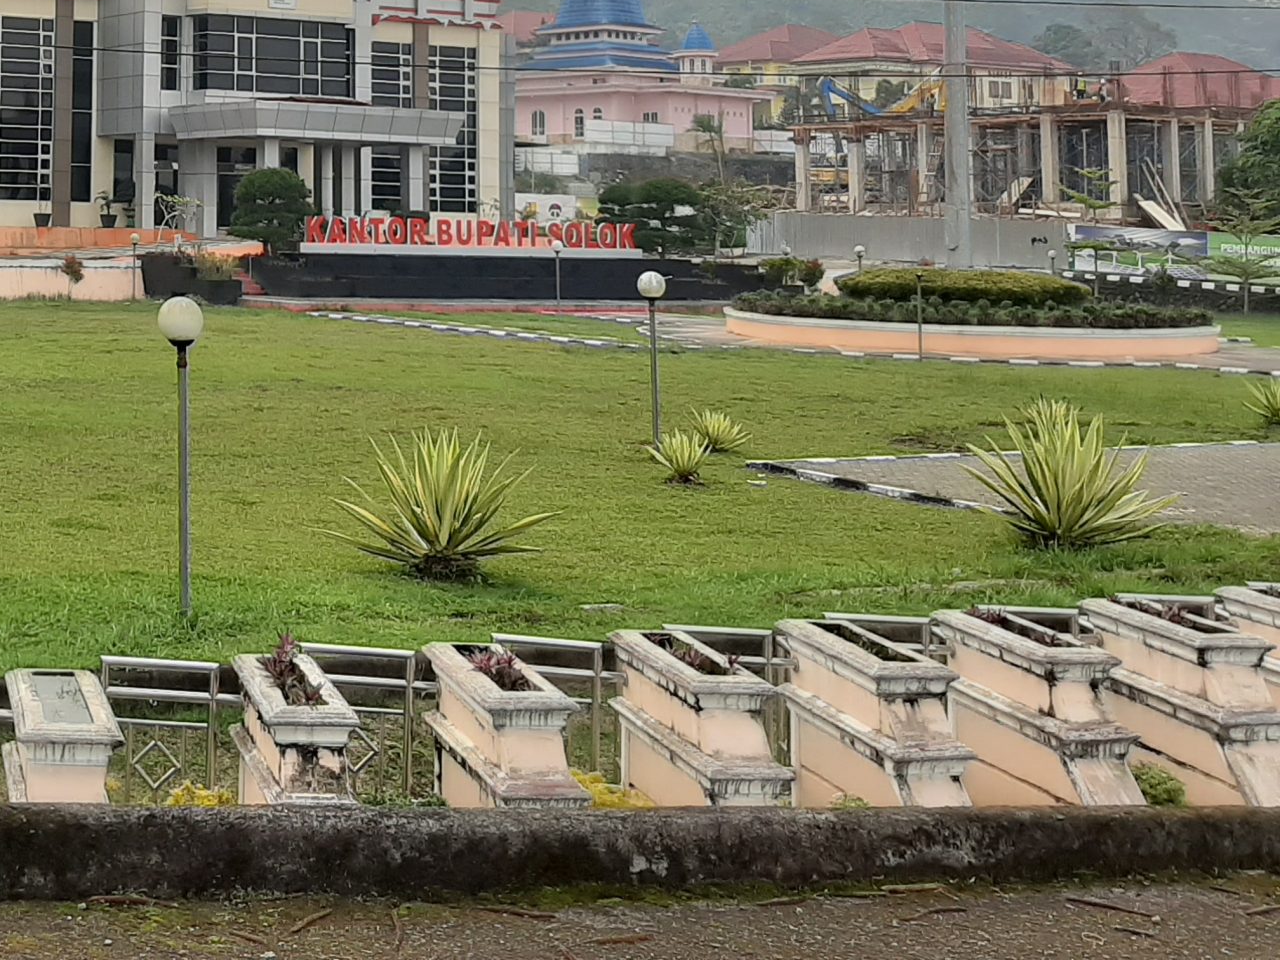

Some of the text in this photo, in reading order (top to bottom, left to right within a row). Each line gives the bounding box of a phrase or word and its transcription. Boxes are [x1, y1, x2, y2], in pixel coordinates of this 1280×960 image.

[304, 215, 636, 248] KANTOR BUPATI SOLOK
